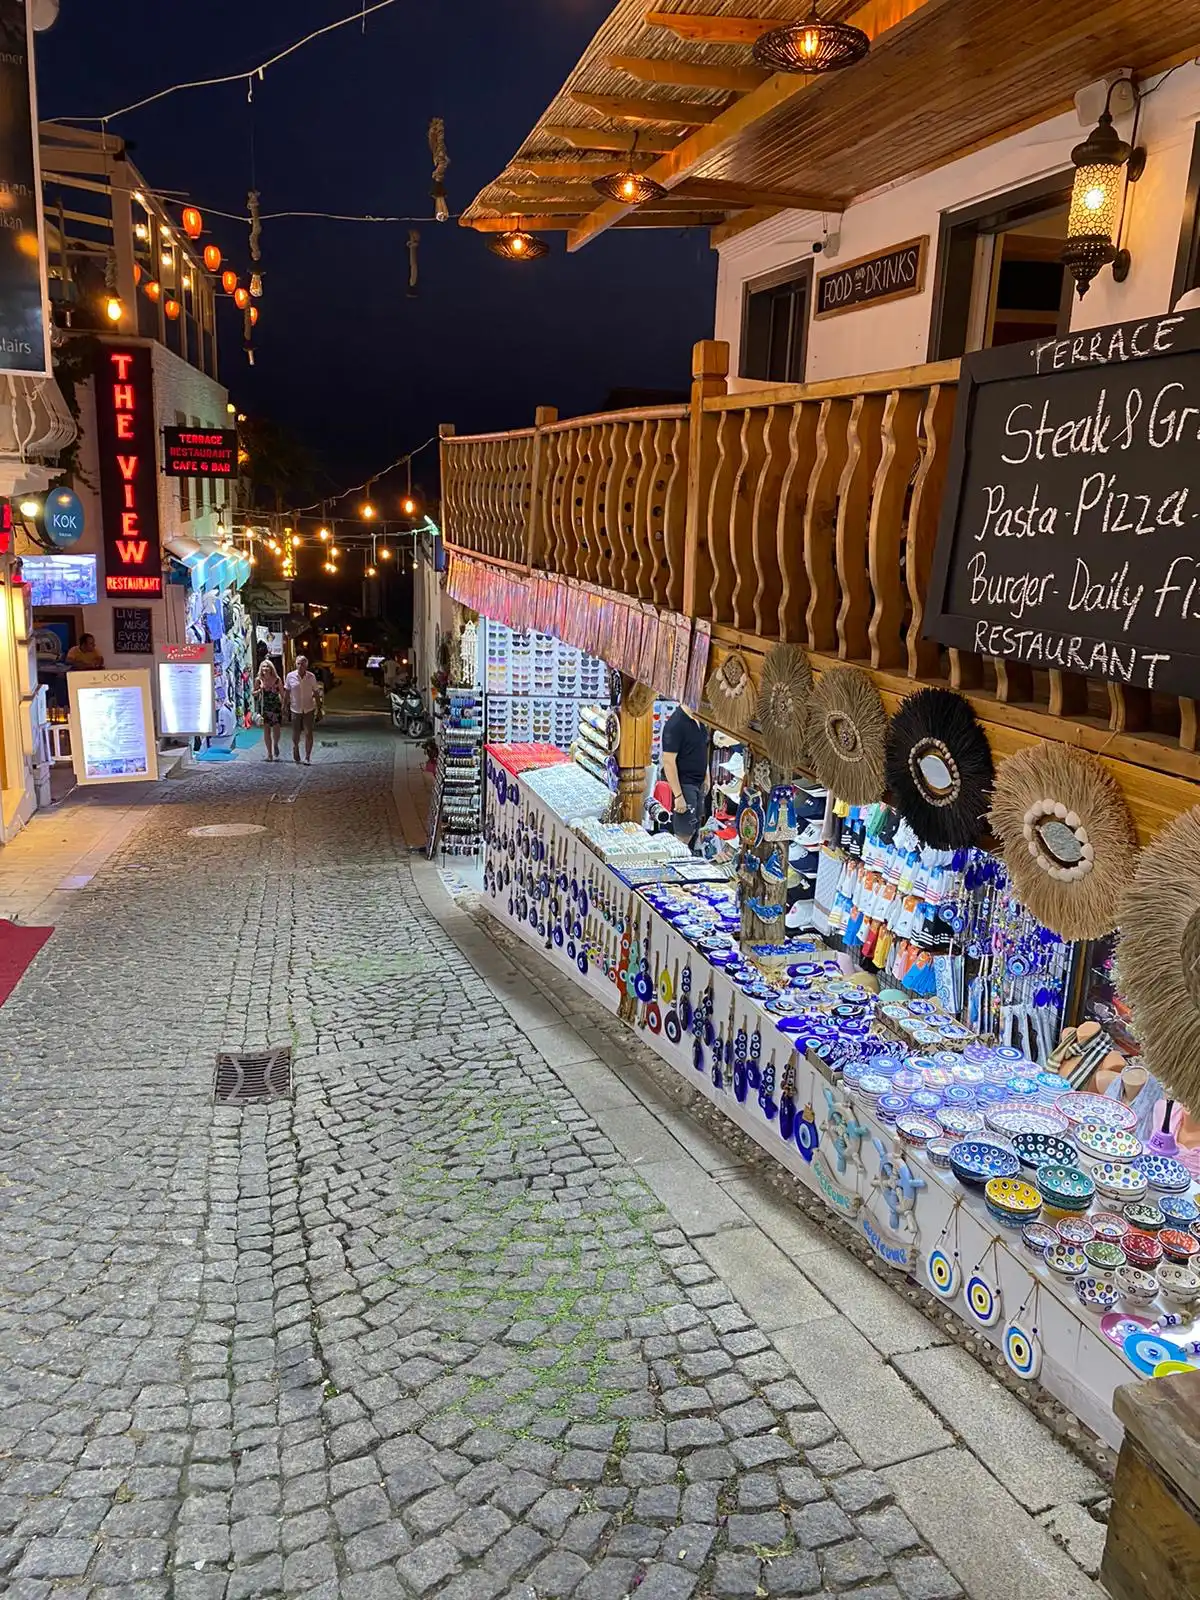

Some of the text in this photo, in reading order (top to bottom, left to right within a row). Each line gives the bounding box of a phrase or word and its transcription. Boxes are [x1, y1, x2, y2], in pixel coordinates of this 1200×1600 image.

[824, 273, 853, 309] FOOD
[865, 251, 917, 294] DRINKS
[1031, 316, 1185, 374] TERRACE
[1001, 389, 1110, 464] Steak
[1149, 382, 1200, 448] Gr
[178, 434, 223, 445] TERRACE
[111, 354, 148, 563] THE VIEW
[170, 447, 232, 459] RESTAURANT
[173, 461, 198, 471] CAFE
[211, 462, 231, 472] BAR
[53, 514, 77, 529] KOK
[106, 576, 160, 591] RESTAURANT
[1068, 558, 1144, 631] Daily
[116, 609, 142, 619] LIVE
[118, 631, 150, 642] EVERY
[974, 620, 1171, 689] RESTAURANT
[103, 673, 128, 682] KOK
